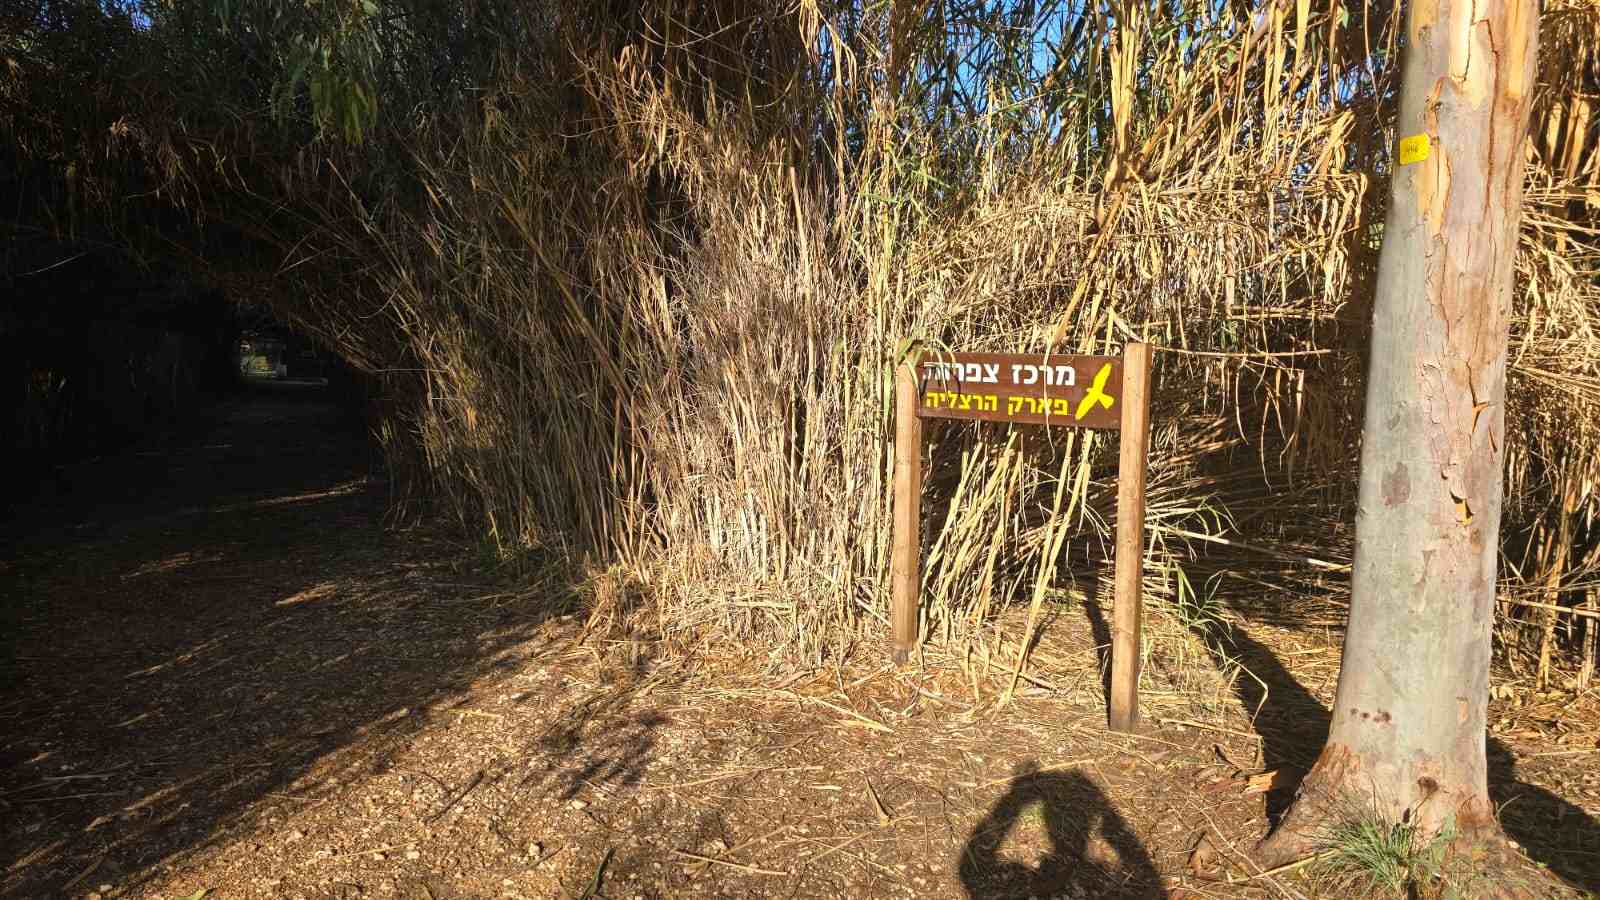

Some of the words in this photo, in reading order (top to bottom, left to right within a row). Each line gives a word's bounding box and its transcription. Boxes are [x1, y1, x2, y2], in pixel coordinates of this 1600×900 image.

[1011, 364, 1076, 386] מרכז
[927, 391, 998, 411] הרצליה
[1008, 396, 1069, 416] פארק
